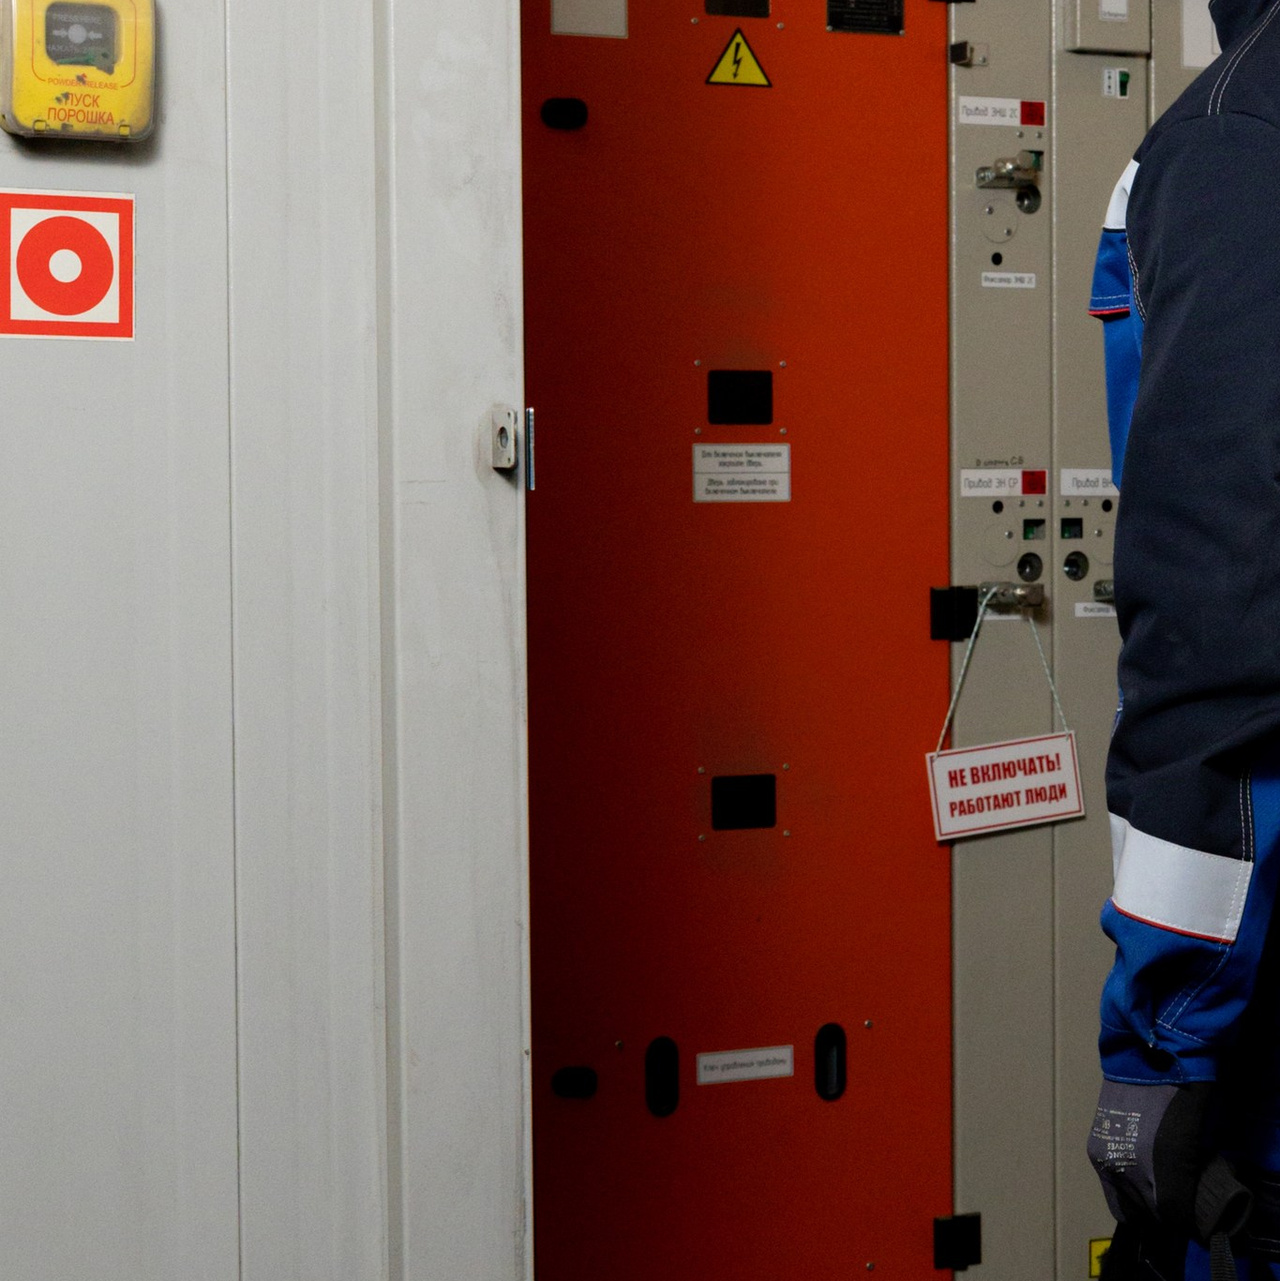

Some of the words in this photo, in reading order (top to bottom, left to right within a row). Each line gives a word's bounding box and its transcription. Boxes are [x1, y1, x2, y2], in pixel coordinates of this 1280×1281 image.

[65, 93, 100, 109] ПУСК
[48, 107, 115, 126] ПОРОШКА
[948, 768, 968, 789] НЕ
[970, 753, 1062, 785] ВКЛЮЧАТЬ!
[949, 790, 1022, 818] РАБОТАЮТ
[1025, 783, 1068, 806] ЛЮДИ
